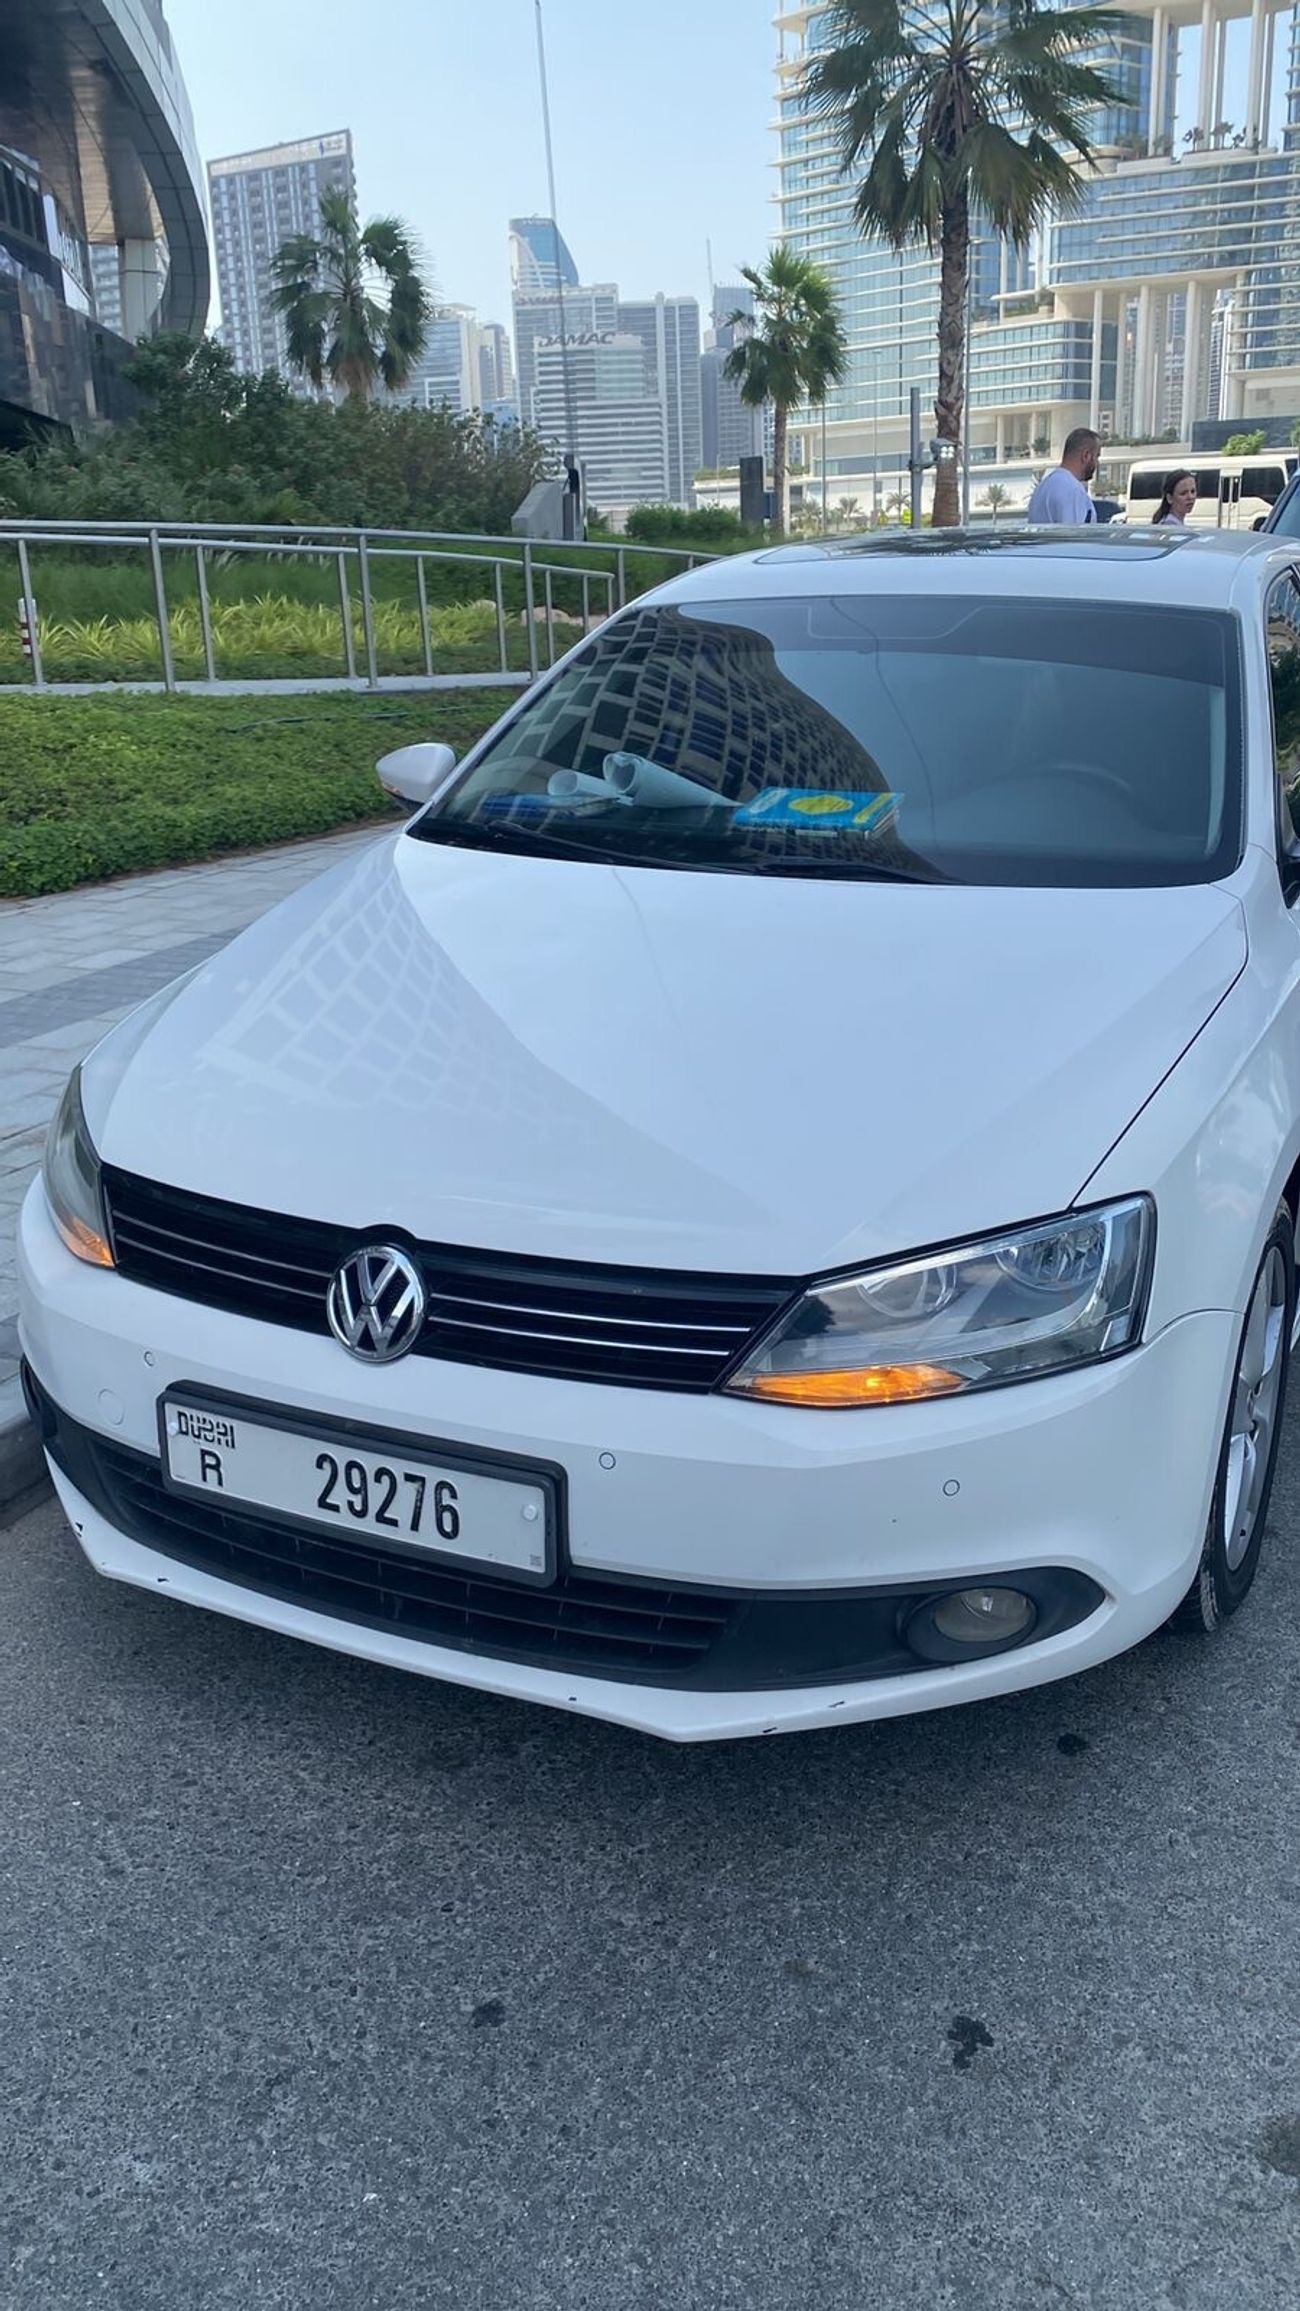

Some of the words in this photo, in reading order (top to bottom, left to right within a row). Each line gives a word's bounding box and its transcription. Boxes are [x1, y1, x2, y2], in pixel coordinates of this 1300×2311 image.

[538, 332, 615, 347] DAMAC
[200, 1448, 223, 1487] R
[315, 1453, 460, 1540] 29276
